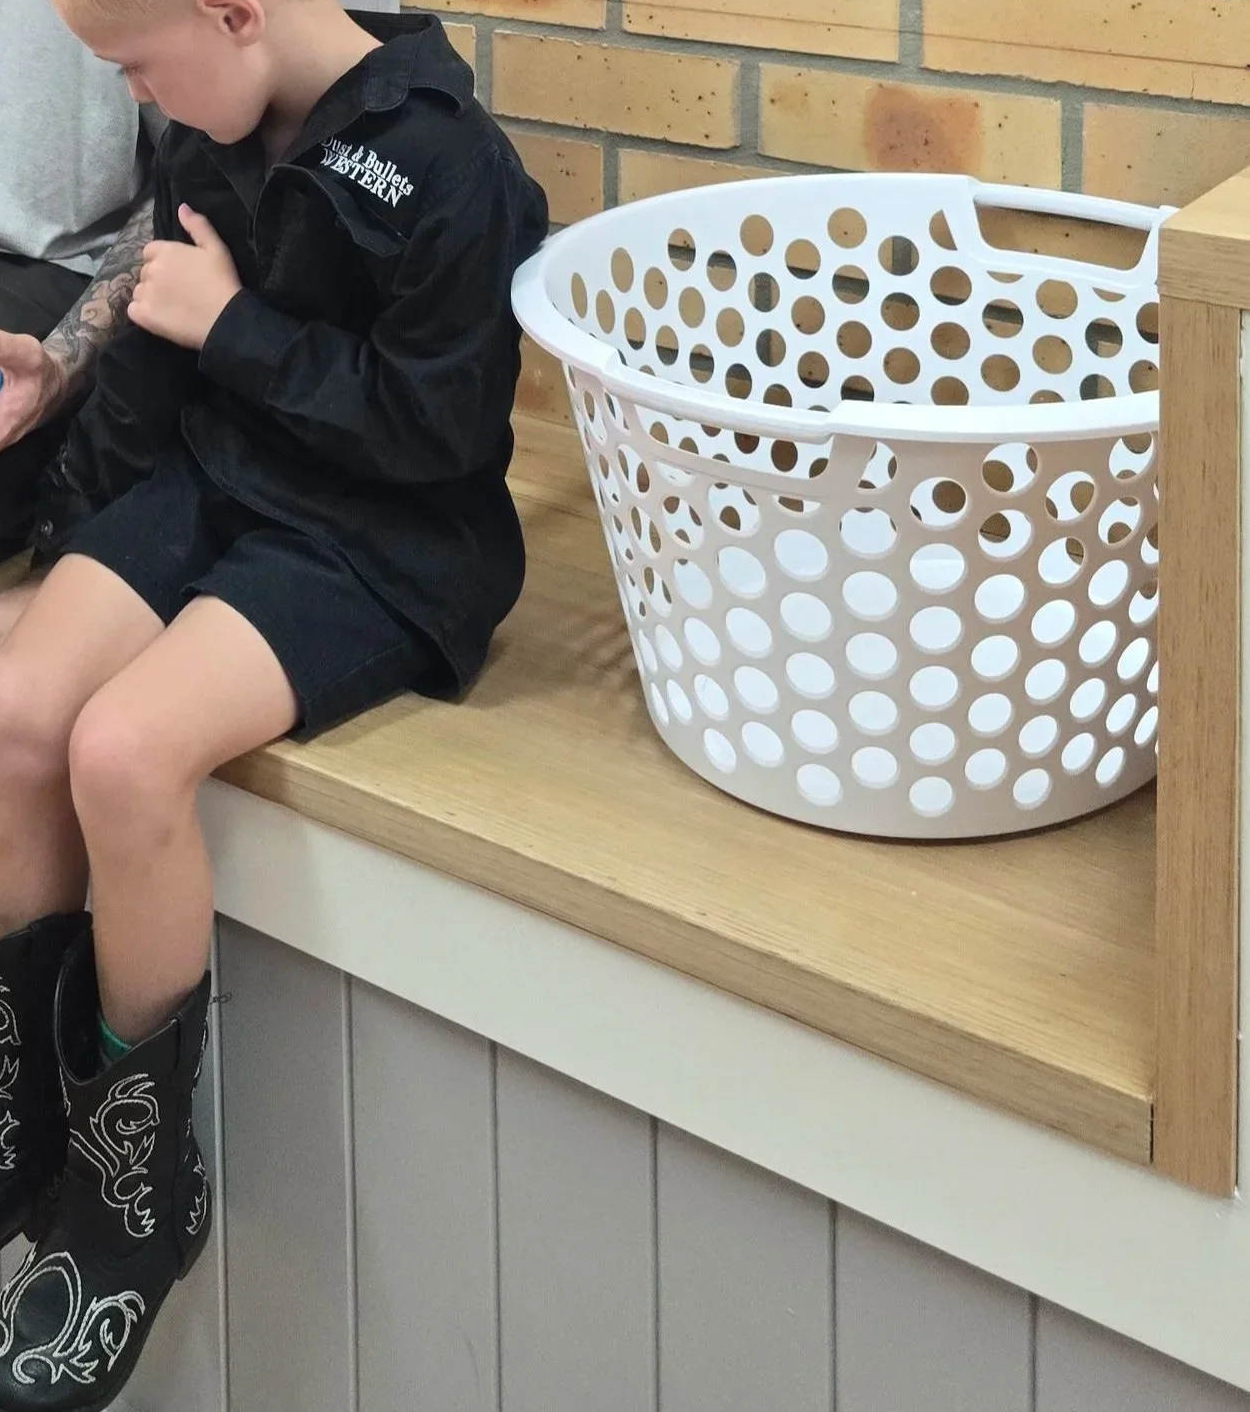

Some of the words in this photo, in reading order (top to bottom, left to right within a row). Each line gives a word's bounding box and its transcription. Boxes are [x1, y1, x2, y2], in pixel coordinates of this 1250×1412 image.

[320, 148, 404, 208] WESTERN
[351, 145, 364, 163] &
[361, 149, 414, 197] Bullets
